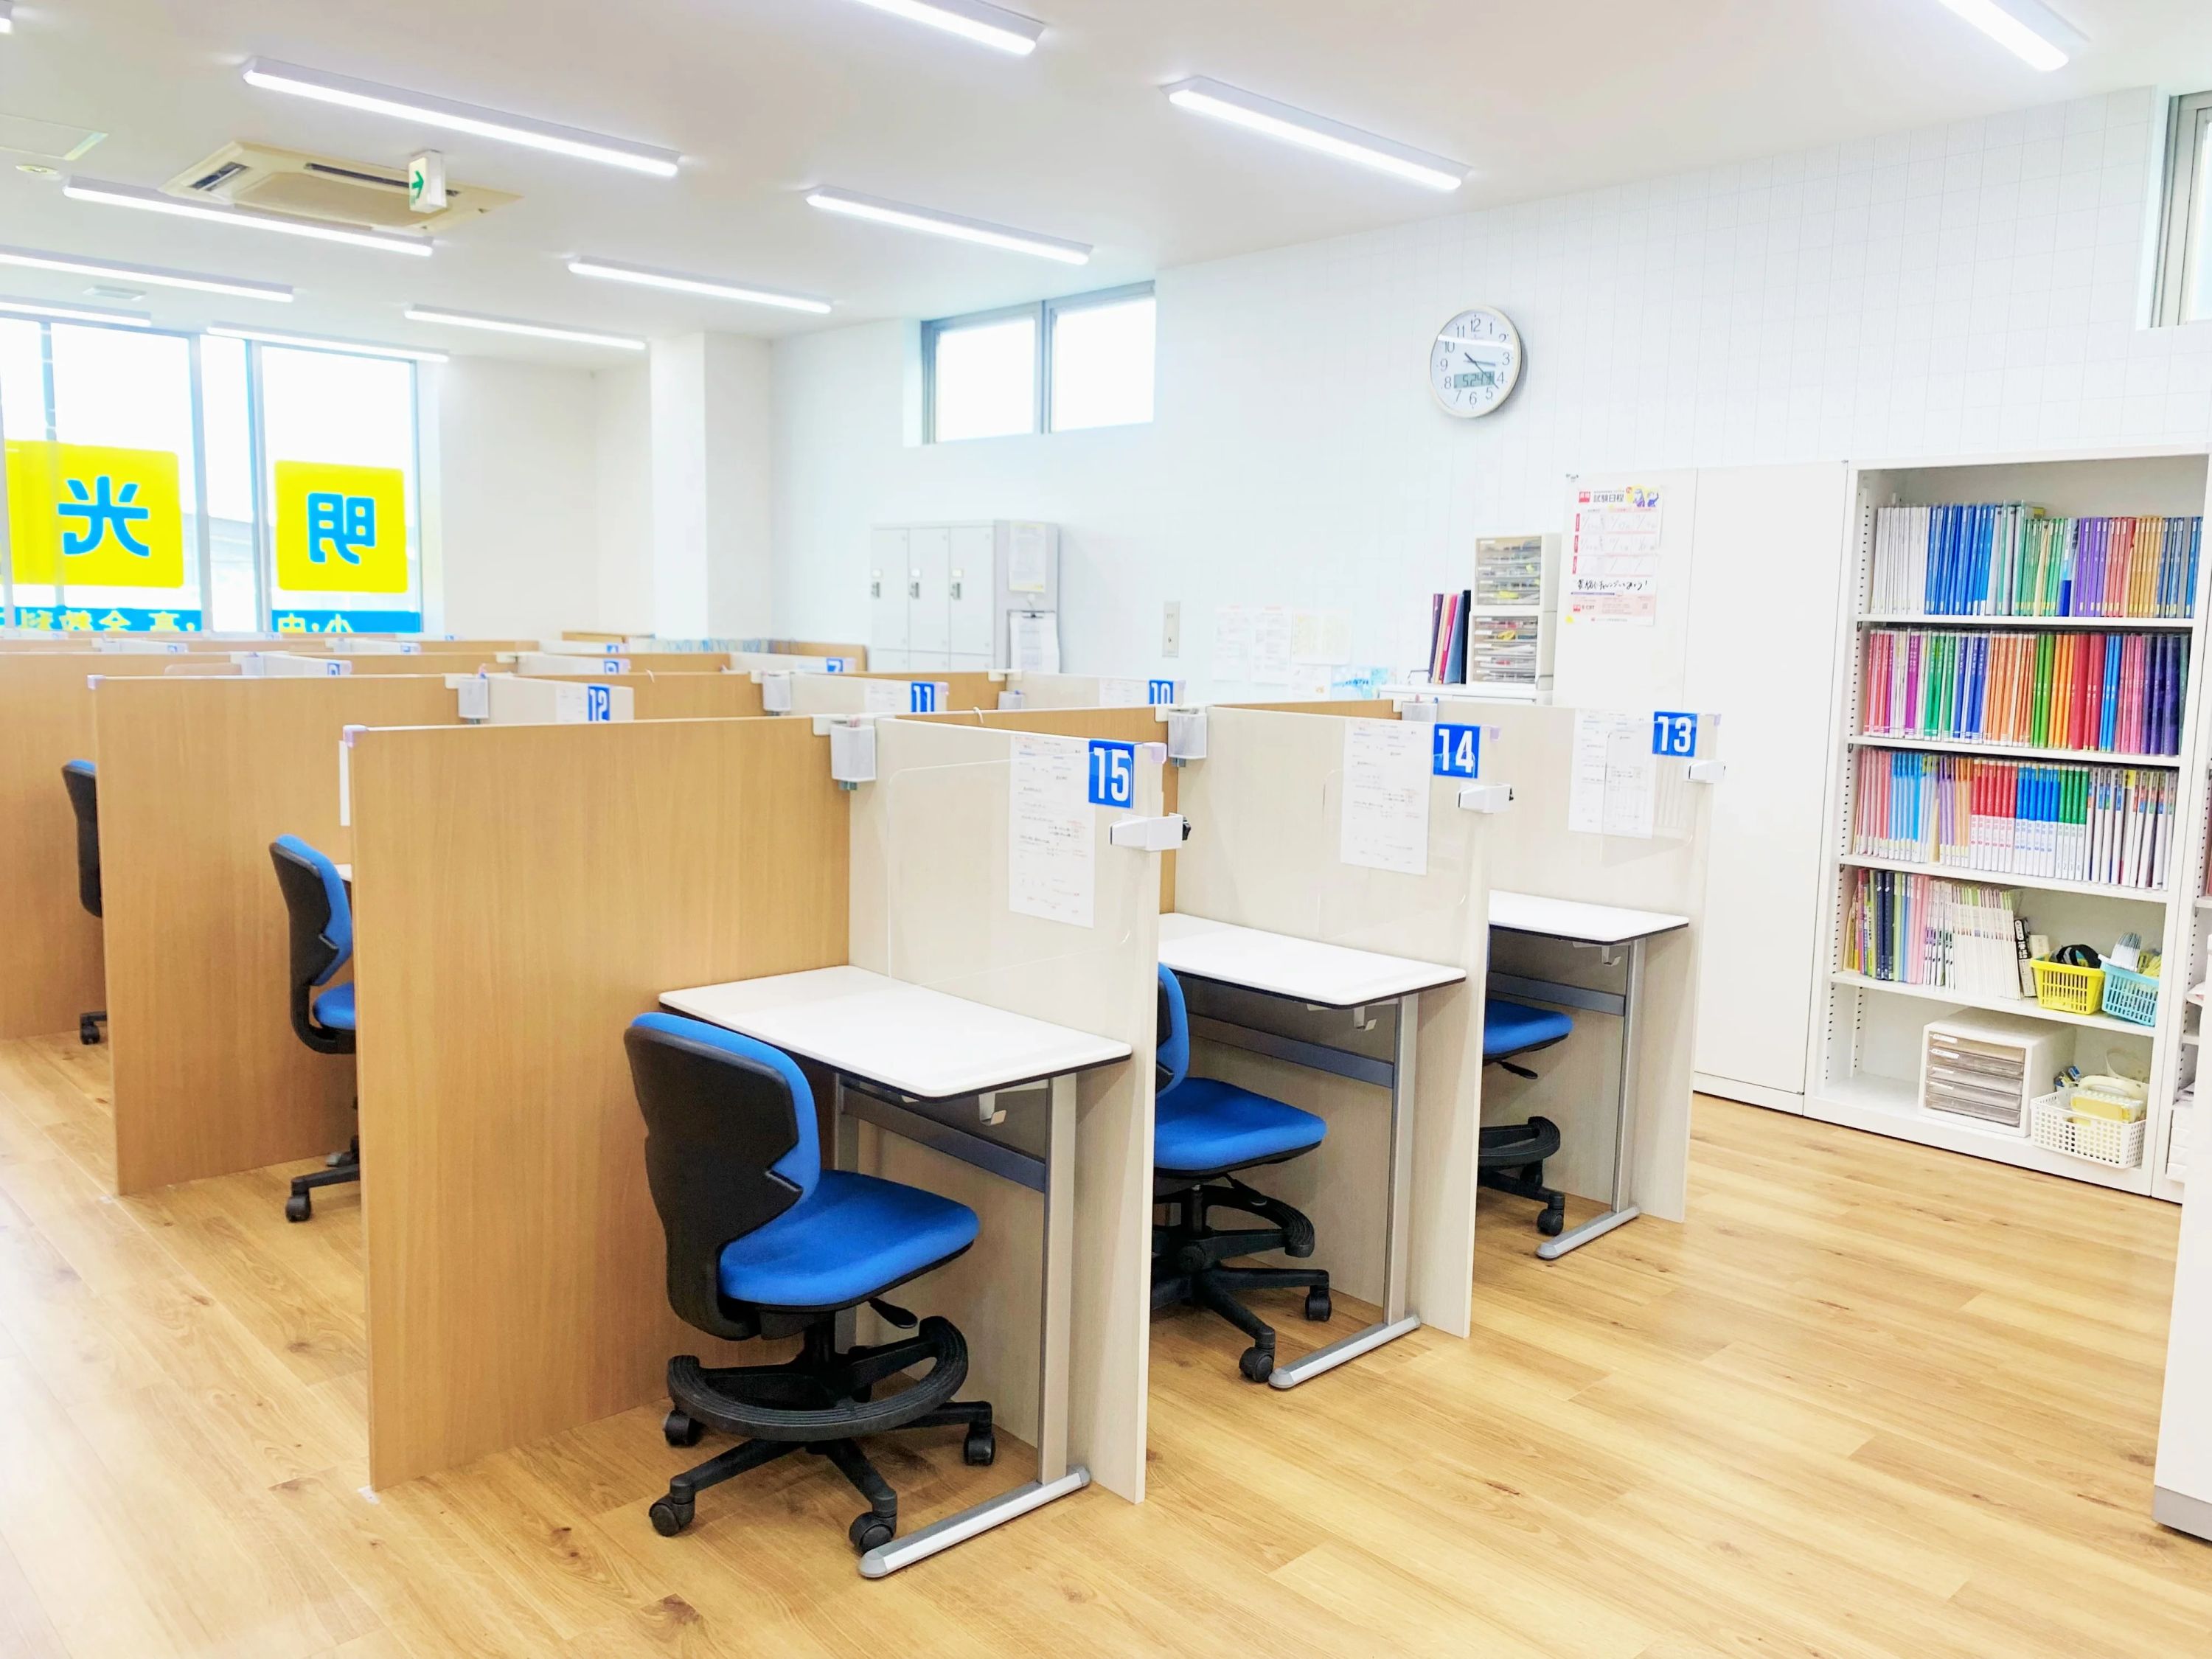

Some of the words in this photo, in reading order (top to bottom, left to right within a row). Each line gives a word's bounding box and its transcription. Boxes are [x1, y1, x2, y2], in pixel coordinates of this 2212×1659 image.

[1457, 324, 1465, 338] 11
[1471, 318, 1481, 333] 12
[1489, 321, 1493, 335] 1
[1444, 340, 1455, 354] 10
[1440, 358, 1448, 372] 9
[1502, 352, 1510, 366] 3
[1444, 376, 1452, 389] 8
[1497, 371, 1504, 384] 4
[1455, 389, 1462, 403] 7
[1469, 391, 1477, 405] 6
[1486, 387, 1493, 400] 5
[589, 689, 608, 722] 12
[913, 685, 932, 712] 11
[1658, 715, 1693, 753] 13
[1438, 728, 1475, 773] 14
[1093, 746, 1130, 802] 15
